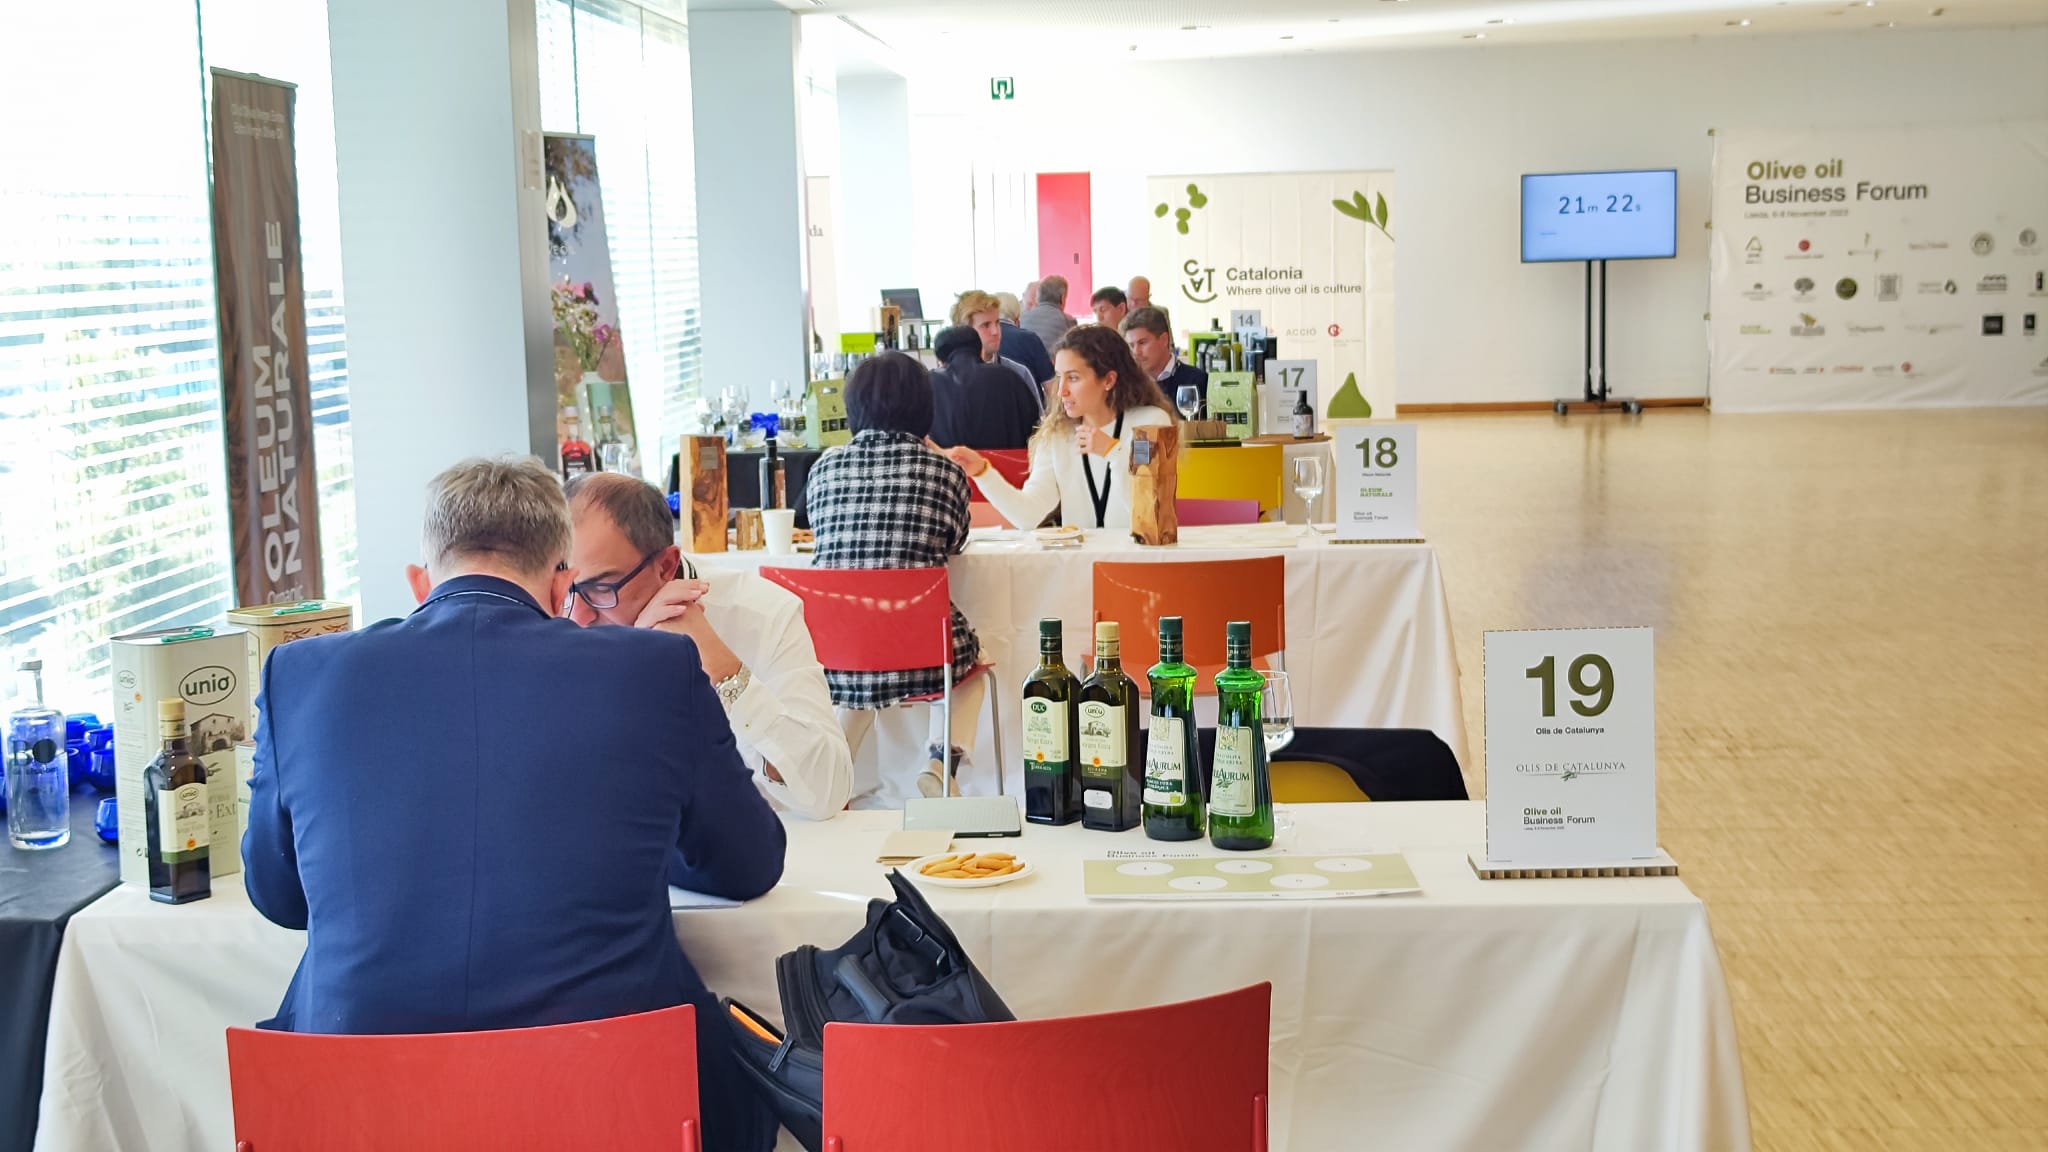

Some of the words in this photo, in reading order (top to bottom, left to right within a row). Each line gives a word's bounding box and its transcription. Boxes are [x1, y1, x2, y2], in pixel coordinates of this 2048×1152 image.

[1746, 160, 1807, 181] Olive
[1814, 158, 1843, 179] oil
[1745, 184, 1846, 204] Business
[1856, 181, 1928, 201] Forum
[1226, 266, 1303, 281] Catalonia
[1226, 285, 1262, 296] Where
[1266, 284, 1291, 295] olive
[1295, 284, 1307, 295] oil
[1311, 284, 1320, 294] is
[1323, 283, 1362, 294] culture
[1237, 314, 1254, 327] 14
[1278, 367, 1305, 388] 17
[265, 221, 302, 575] NATURALE
[1355, 437, 1398, 468] 18
[252, 345, 283, 583] OLEUM
[1525, 653, 1615, 718] 19
[1553, 727, 1563, 735] de
[1565, 726, 1605, 735] Catalunya
[1516, 763, 1540, 772] OLIS
[1545, 763, 1559, 772] DE
[1562, 762, 1625, 771] CATALUNYA
[1523, 807, 1548, 816] Olive
[1550, 806, 1562, 815] oil
[1523, 816, 1564, 825] Business
[1567, 815, 1596, 824] Forum
